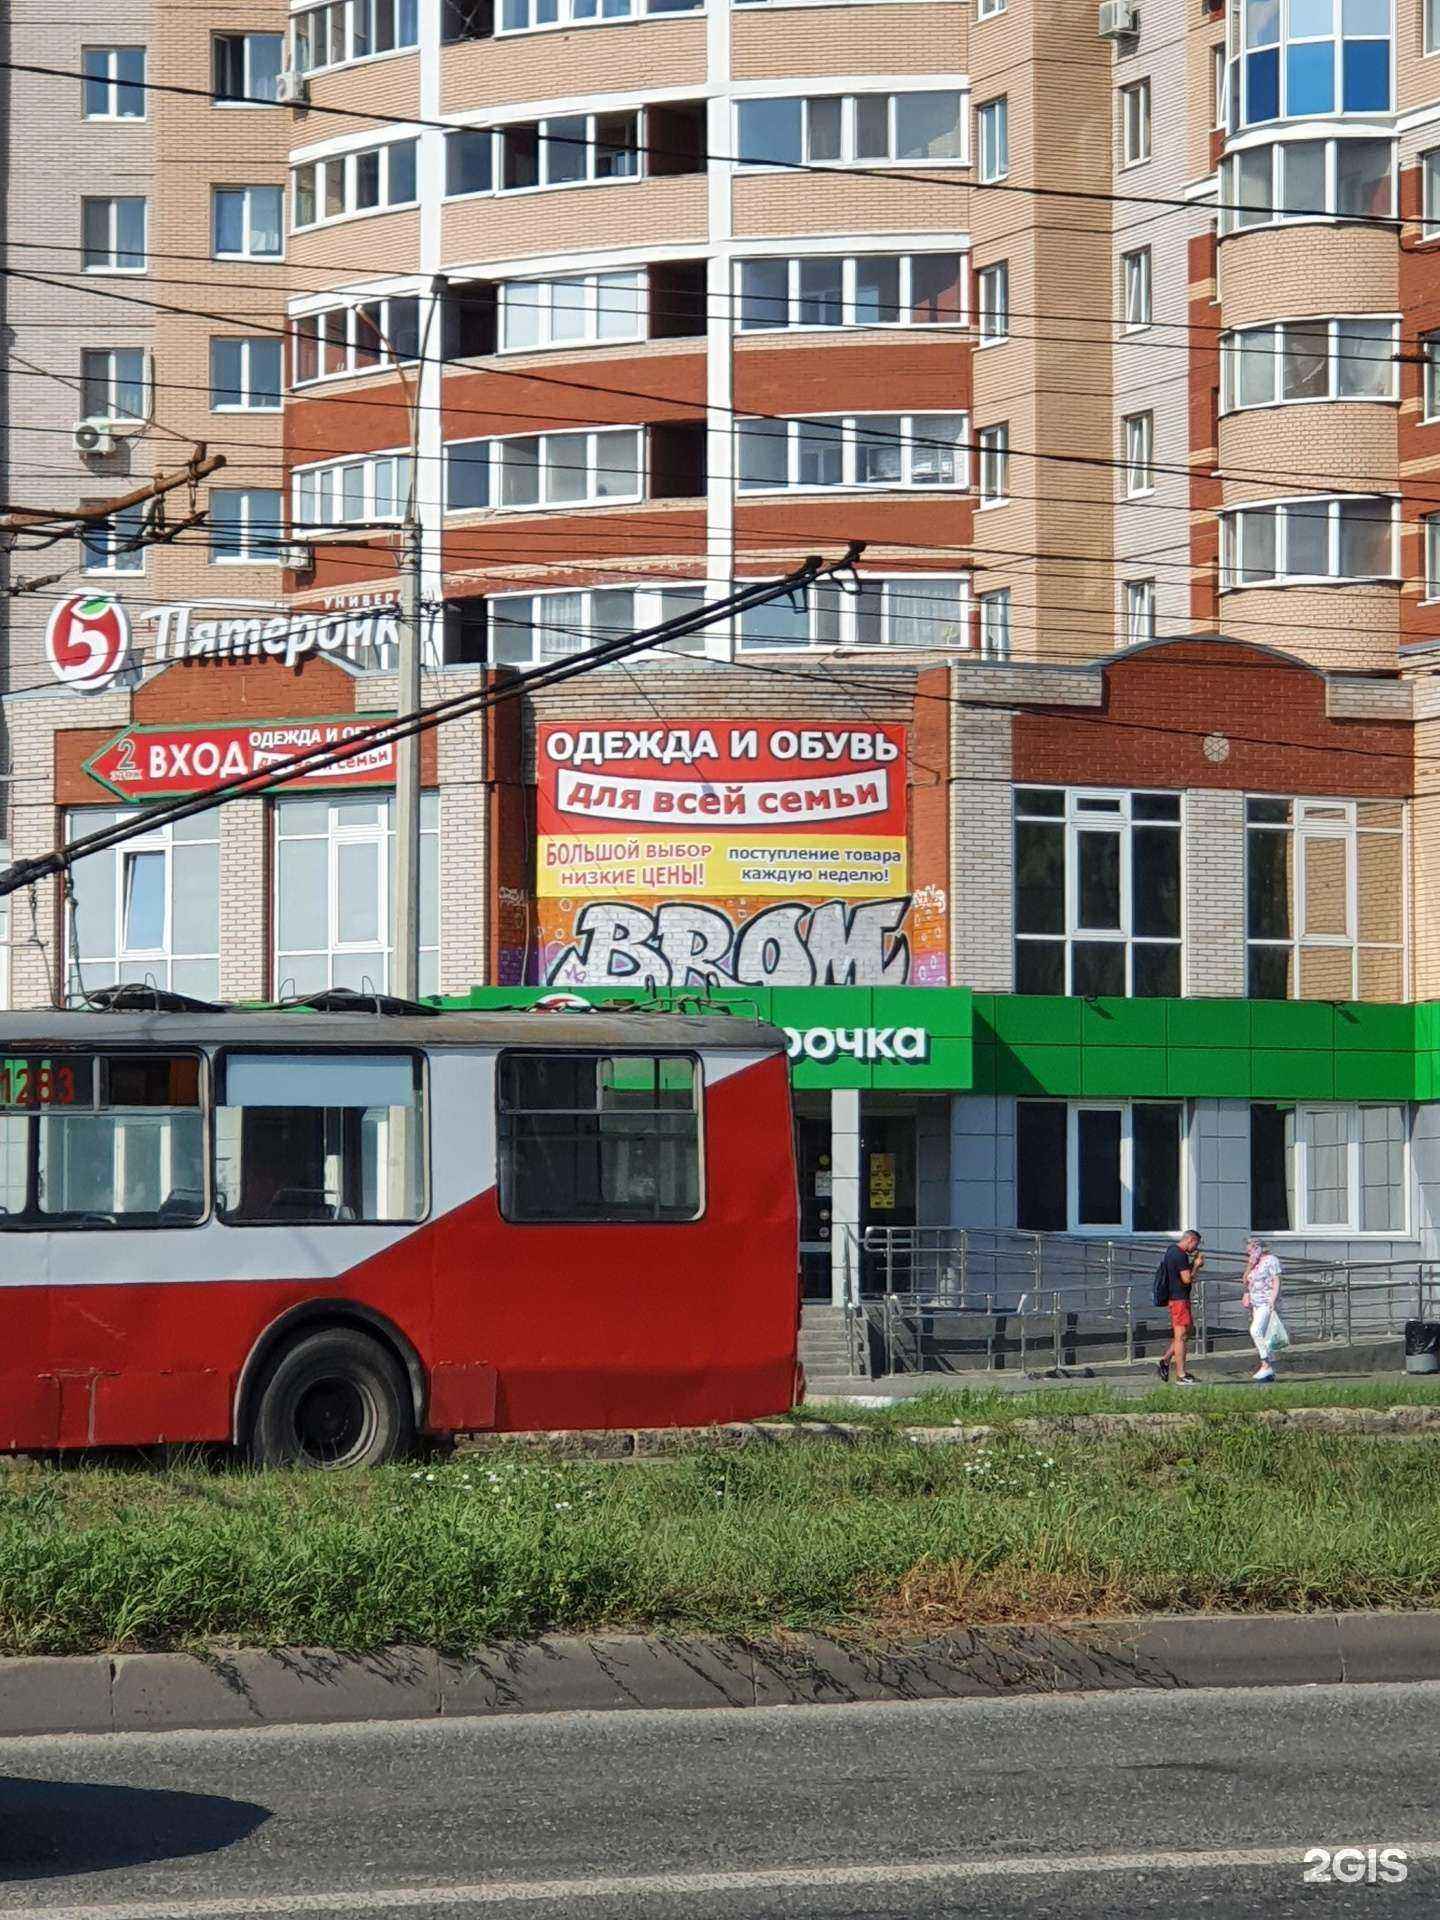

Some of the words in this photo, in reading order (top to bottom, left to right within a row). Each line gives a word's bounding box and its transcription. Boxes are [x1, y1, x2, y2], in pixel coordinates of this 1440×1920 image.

[323, 590, 401, 609] УНИВЕР
[140, 607, 400, 668] Пятерочк
[249, 729, 322, 748] ОДЕЖДА
[326, 730, 338, 743] И
[547, 730, 719, 766] ОДЕЖДА
[730, 730, 758, 759] И
[769, 730, 898, 761] ОБУВЬ
[116, 738, 136, 770] 2
[150, 741, 249, 778] ВХОД
[567, 782, 642, 809] для
[652, 786, 746, 815] всей
[757, 782, 879, 814] семьи
[546, 839, 640, 866] БОЛЬШОЙ
[645, 844, 712, 859] ВЫБОР
[729, 848, 840, 863] поступление
[844, 850, 901, 864] товара
[561, 869, 636, 886] НИЗКИЕ
[642, 863, 704, 888] ЦЕНЫ!
[742, 868, 812, 883] каждую
[818, 869, 889, 883] неделю!
